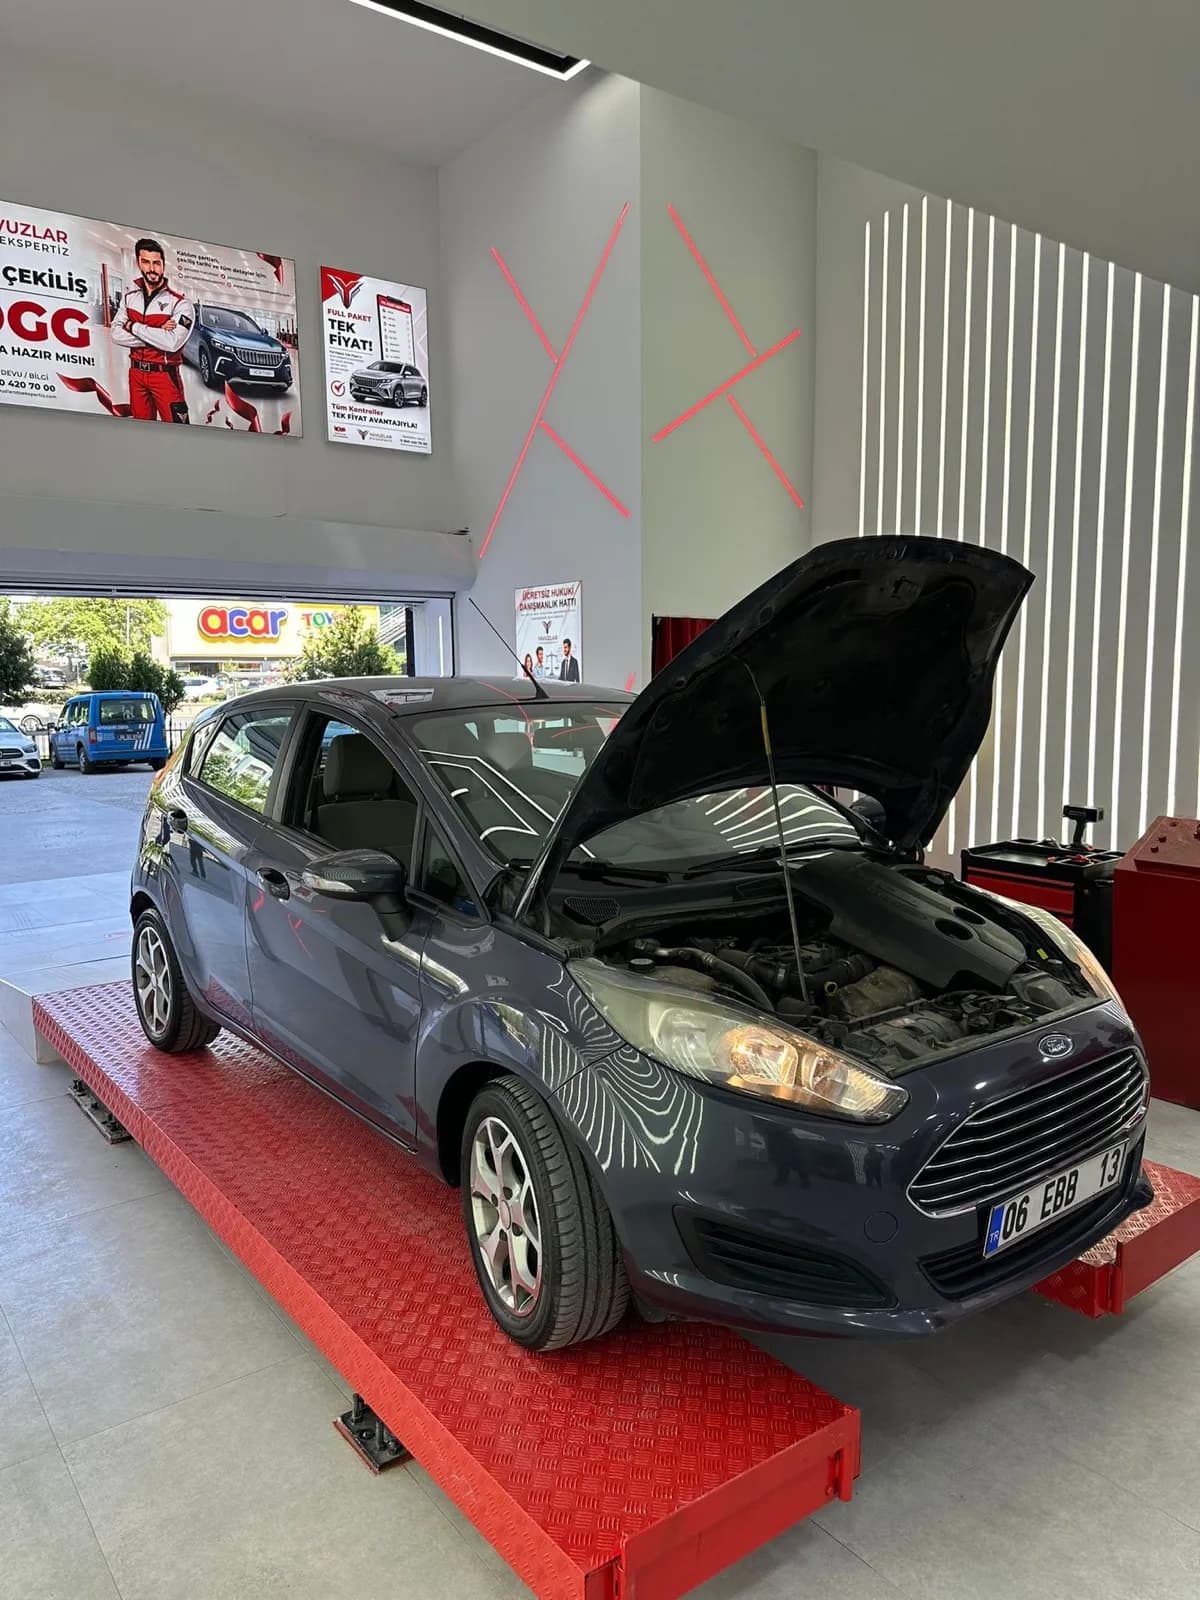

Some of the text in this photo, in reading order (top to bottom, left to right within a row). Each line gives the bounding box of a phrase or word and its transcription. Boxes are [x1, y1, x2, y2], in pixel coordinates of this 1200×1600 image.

[2, 265, 88, 298] ÇEKİLİŞ
[0, 300, 91, 348] GG
[327, 308, 372, 322] FULL PAKET
[328, 318, 356, 334] TEK
[329, 332, 373, 351] FİYAT!
[11, 346, 52, 361] HAZIR
[55, 352, 95, 366] MISIN!
[8, 380, 27, 389] 420
[28, 382, 41, 390] 70
[43, 384, 56, 392] 00
[331, 403, 384, 416] Tüm Kontroller
[331, 411, 418, 429] TEK FİYAT AVANTAJIYLA!
[522, 588, 550, 600] ÜCRETSİZ
[519, 597, 577, 611] DANIŞMANLIK HATTI
[200, 607, 286, 636] acar
[989, 1148, 1121, 1243] TR 06 EBB 13
